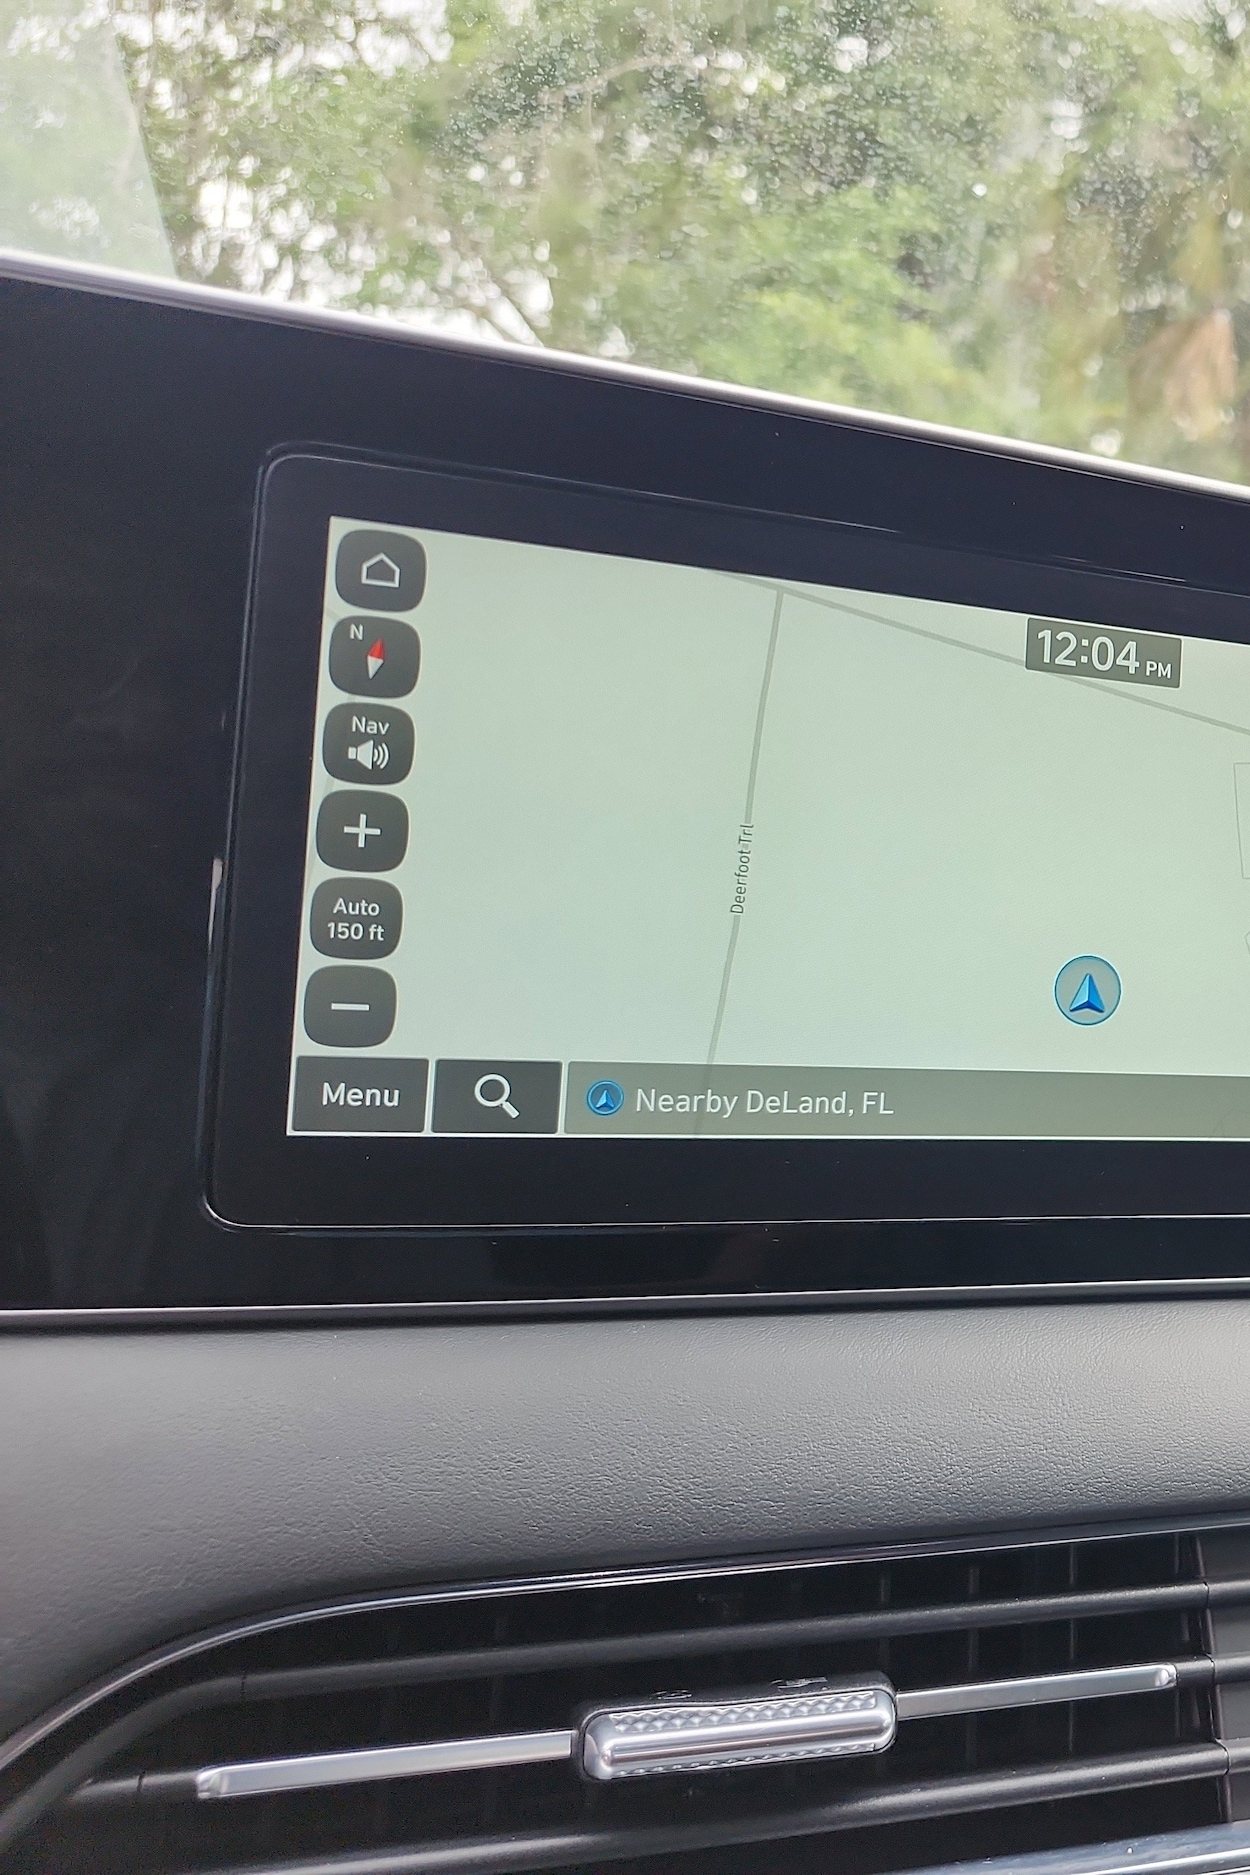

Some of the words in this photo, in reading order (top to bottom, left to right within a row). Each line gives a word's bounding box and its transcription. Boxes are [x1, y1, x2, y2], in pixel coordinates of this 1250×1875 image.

[349, 623, 364, 641] N
[1037, 629, 1140, 674] 12:04
[1145, 660, 1172, 679] PM
[351, 715, 390, 736] Nav
[738, 824, 754, 845] Trl
[729, 849, 752, 914] Deerfoot
[332, 897, 381, 916] Auto
[326, 922, 364, 940] 150
[368, 924, 385, 941] ft
[321, 1082, 400, 1107] Menu
[635, 1088, 738, 1118] Nearby
[745, 1090, 854, 1117] DeLand,
[862, 1091, 895, 1115] FL
